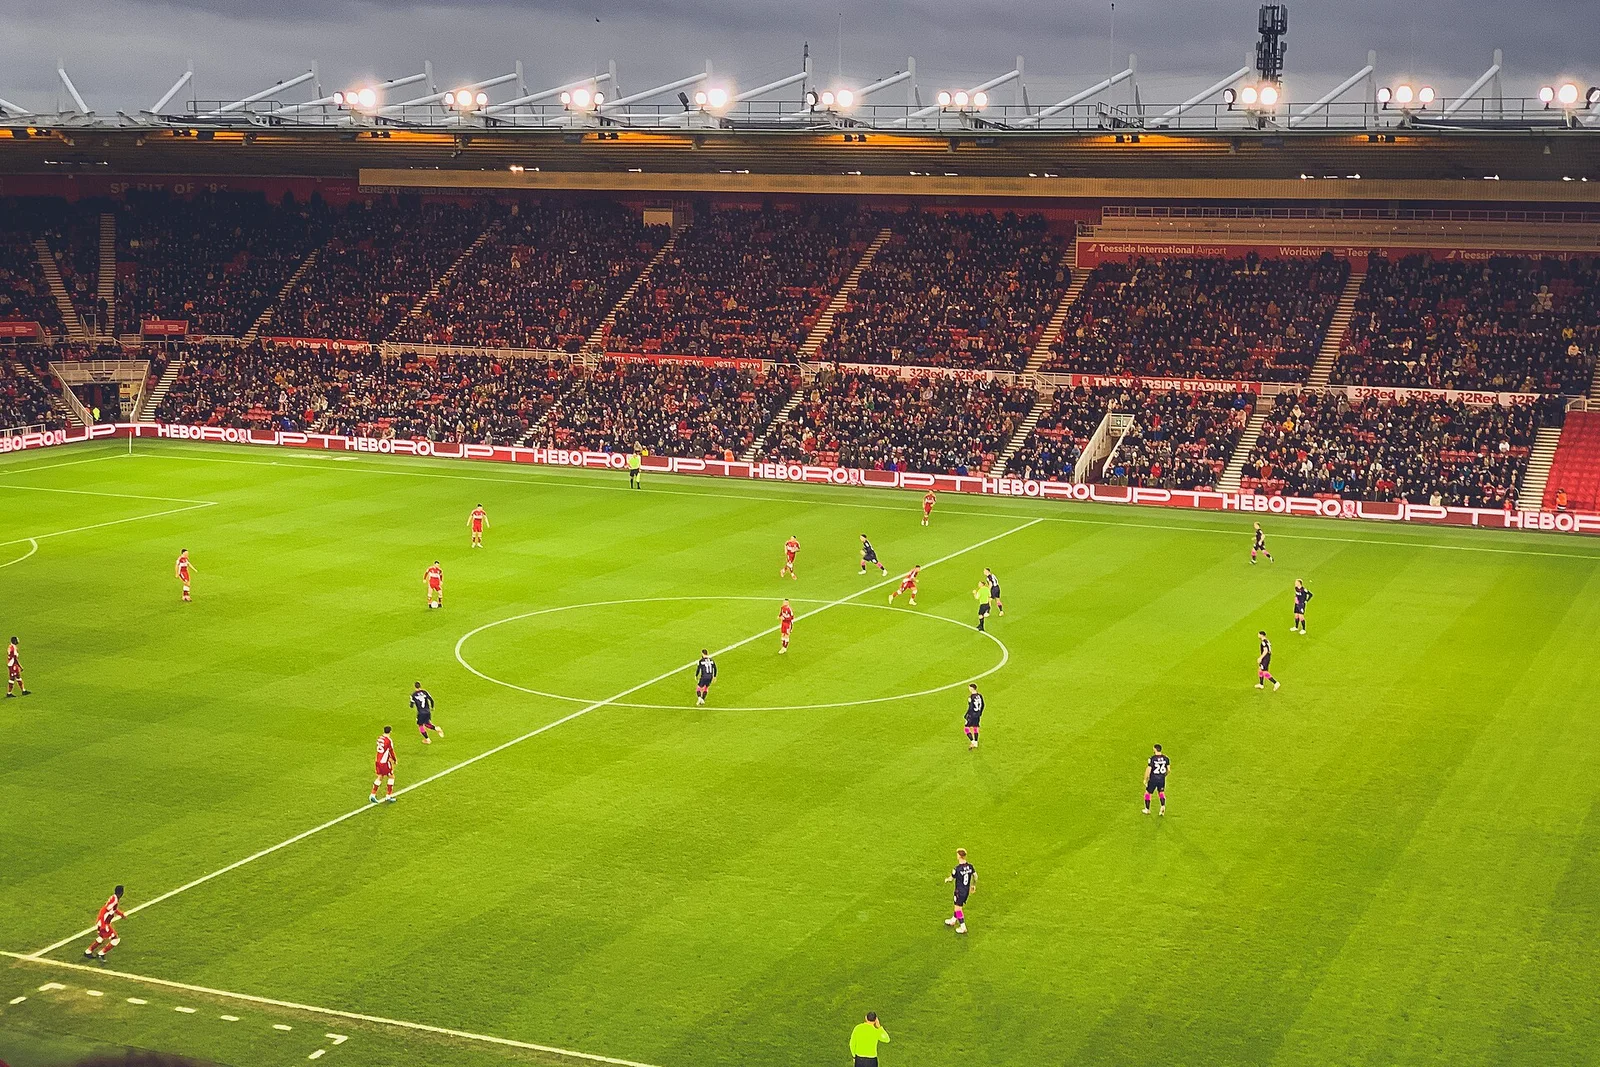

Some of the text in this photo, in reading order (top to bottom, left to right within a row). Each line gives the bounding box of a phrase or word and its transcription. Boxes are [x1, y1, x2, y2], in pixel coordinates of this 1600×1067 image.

[174, 183, 196, 194] OF
[1099, 244, 1228, 256] Teesside International Airport
[1280, 247, 1327, 256] Worldwid
[868, 366, 901, 377] 32Red
[909, 368, 944, 379] 32Red
[952, 370, 988, 381] 32Red
[1183, 381, 1237, 392] STADIUM
[1355, 387, 1537, 406] 32Red 32Red 32Red 32R
[1153, 763, 1167, 774] 26
[963, 873, 969, 886] 8
